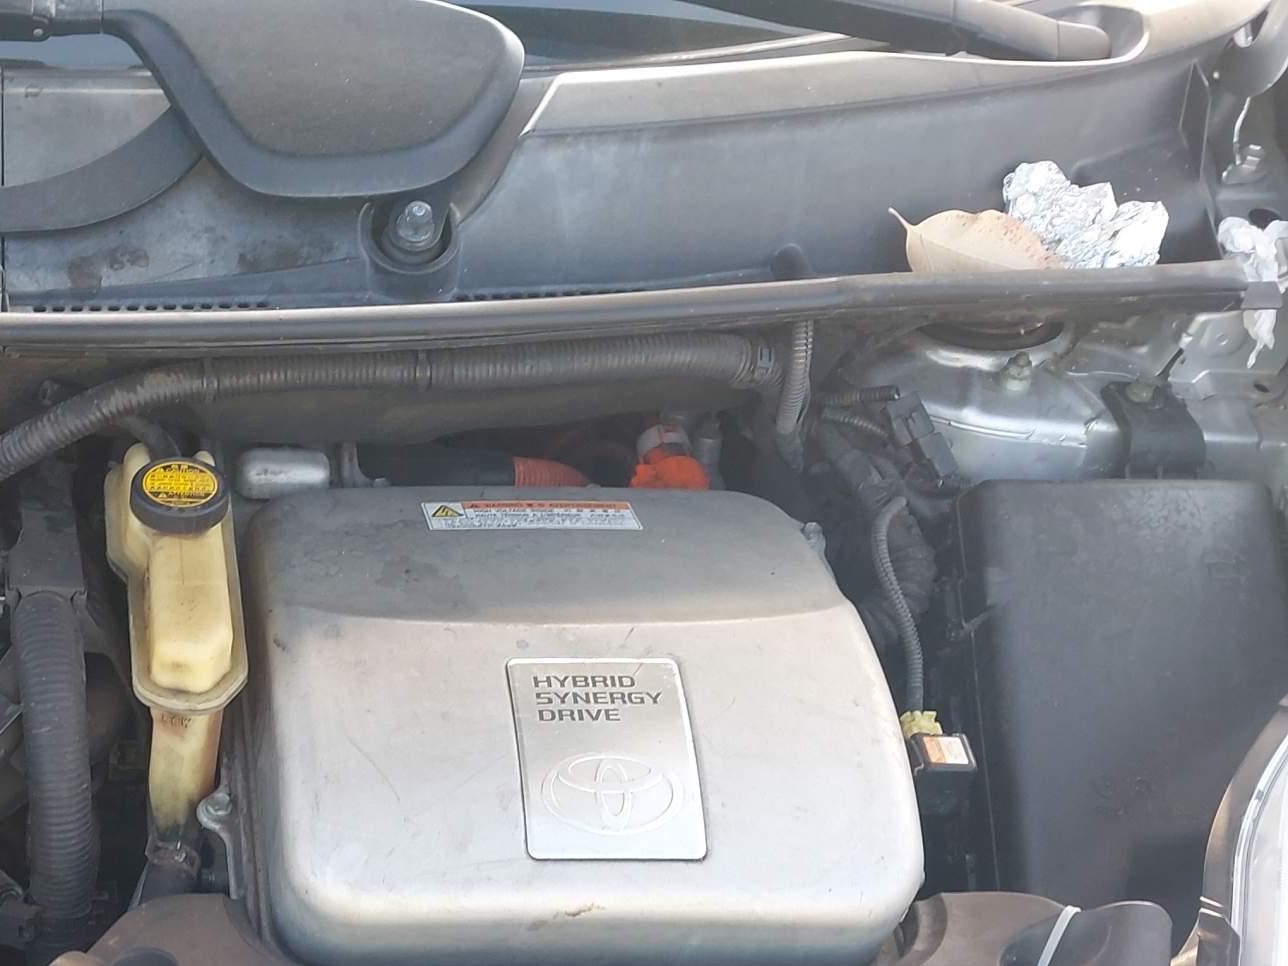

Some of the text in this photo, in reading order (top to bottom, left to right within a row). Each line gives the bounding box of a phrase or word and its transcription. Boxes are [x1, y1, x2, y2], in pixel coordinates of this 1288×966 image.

[532, 675, 636, 688] HYBRID
[535, 691, 663, 705] SYNERGY
[538, 708, 621, 722] DRIVE
